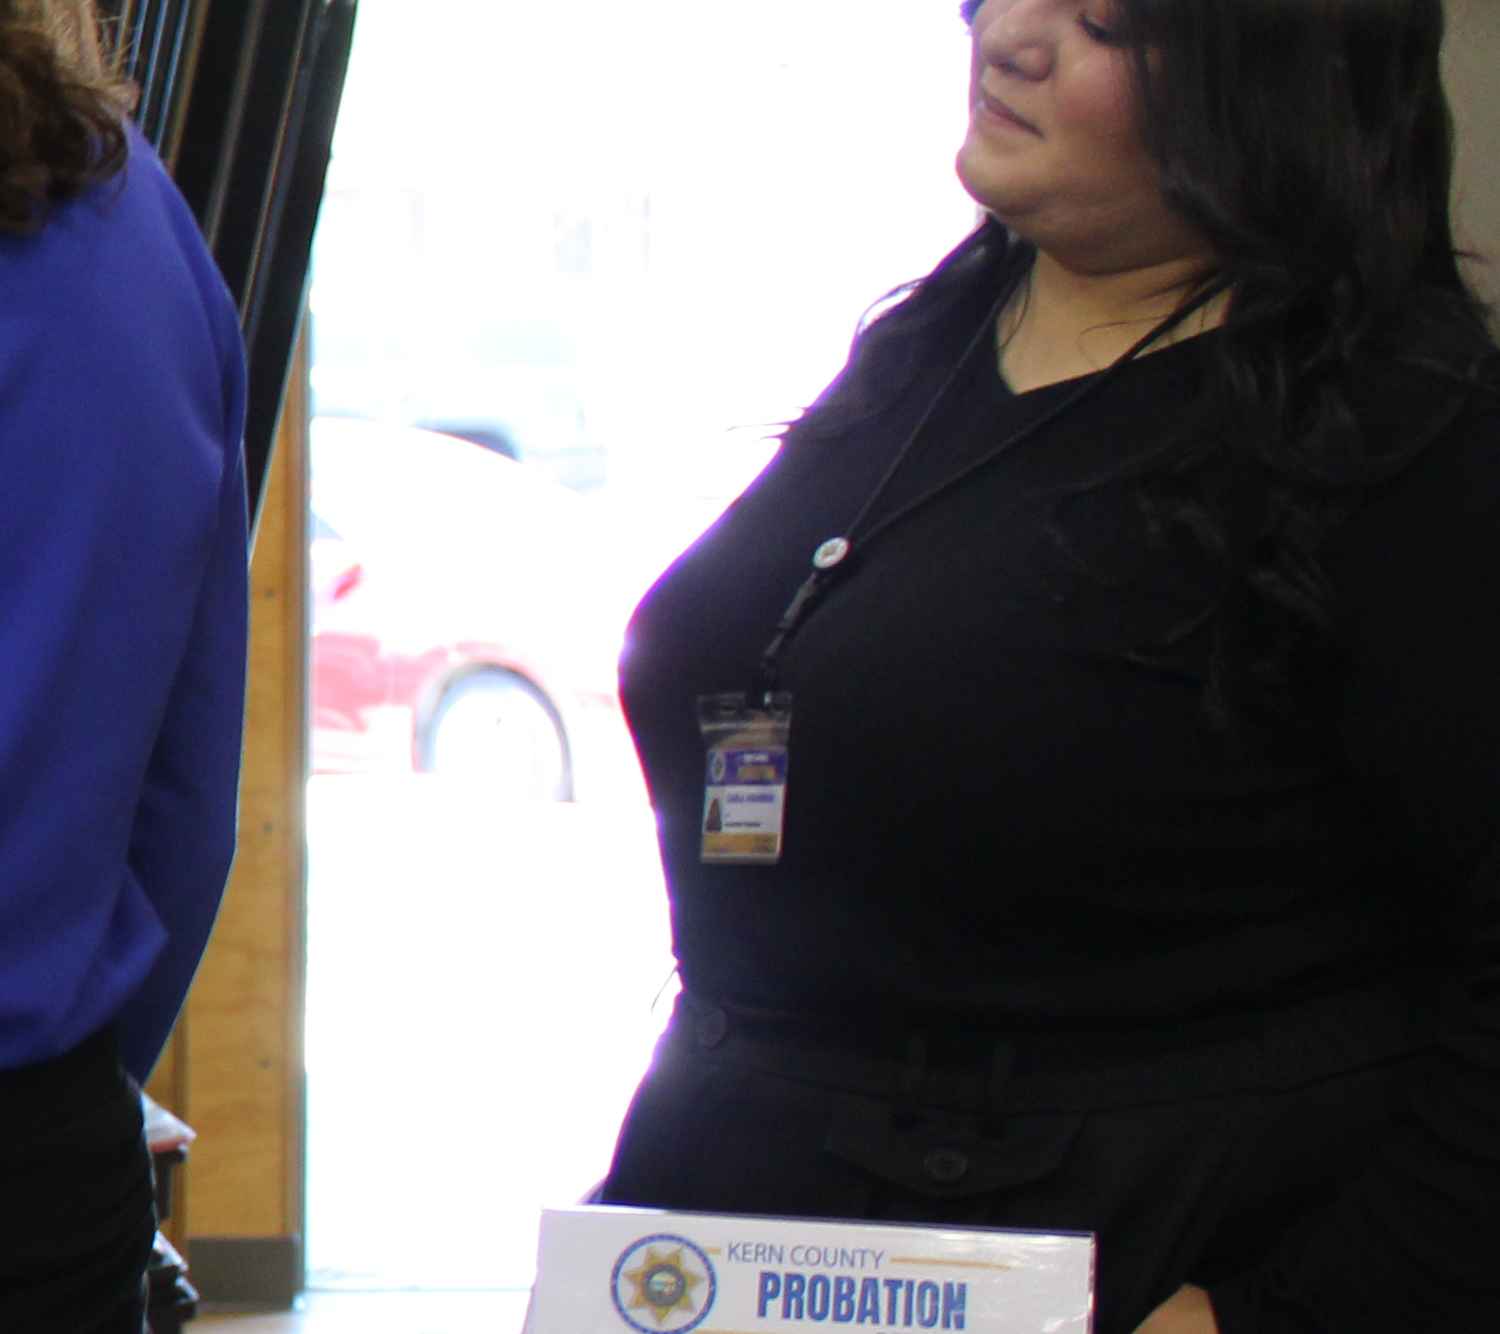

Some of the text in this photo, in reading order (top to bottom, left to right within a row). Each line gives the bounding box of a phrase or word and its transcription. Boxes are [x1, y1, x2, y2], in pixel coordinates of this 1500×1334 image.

[728, 1241, 885, 1269] KERN COUNTY
[756, 1271, 968, 1330] PROBATION
